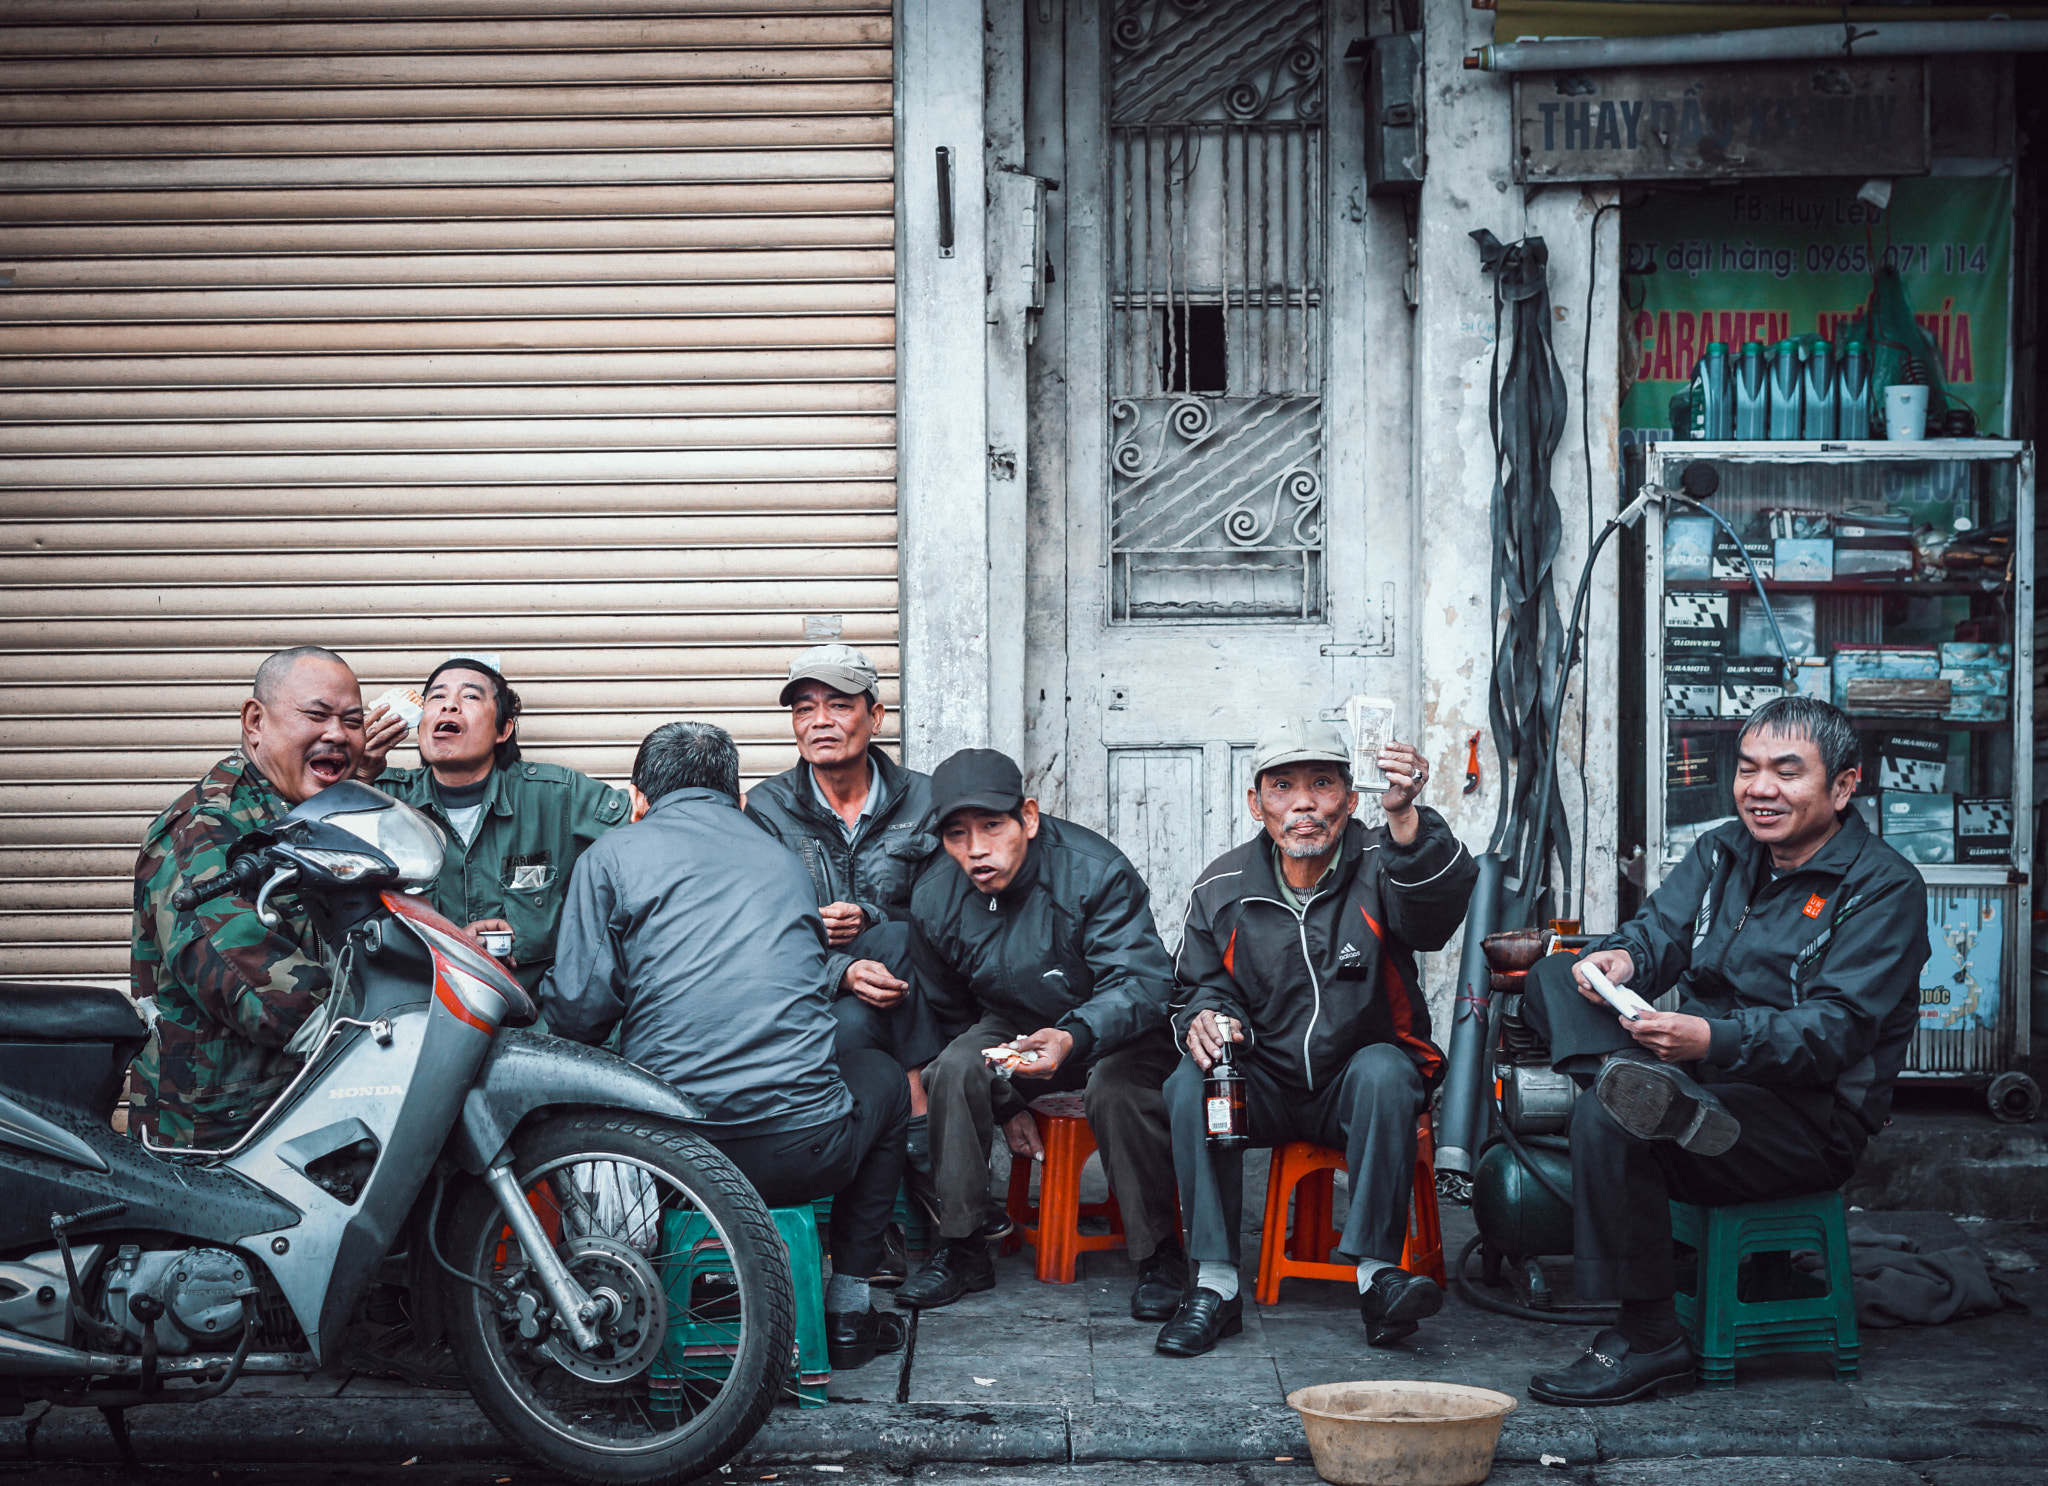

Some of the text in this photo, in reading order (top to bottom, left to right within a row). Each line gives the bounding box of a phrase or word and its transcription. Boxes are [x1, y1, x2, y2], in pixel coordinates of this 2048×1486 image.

[1538, 100, 1644, 152] THAY
[1666, 240, 1713, 278] đặt
[1721, 242, 1799, 278] hàng:
[1882, 245, 1929, 273] 071
[1944, 245, 1987, 273] 114
[1717, 543, 1769, 551] DURMOTO
[1673, 639, 1721, 648] DURAMOTO
[1891, 737, 1940, 750] DURAMOTO
[1969, 848, 2010, 857] URAMOTO
[1338, 950, 1361, 961] adidas
[329, 1085, 405, 1099] HONDA
